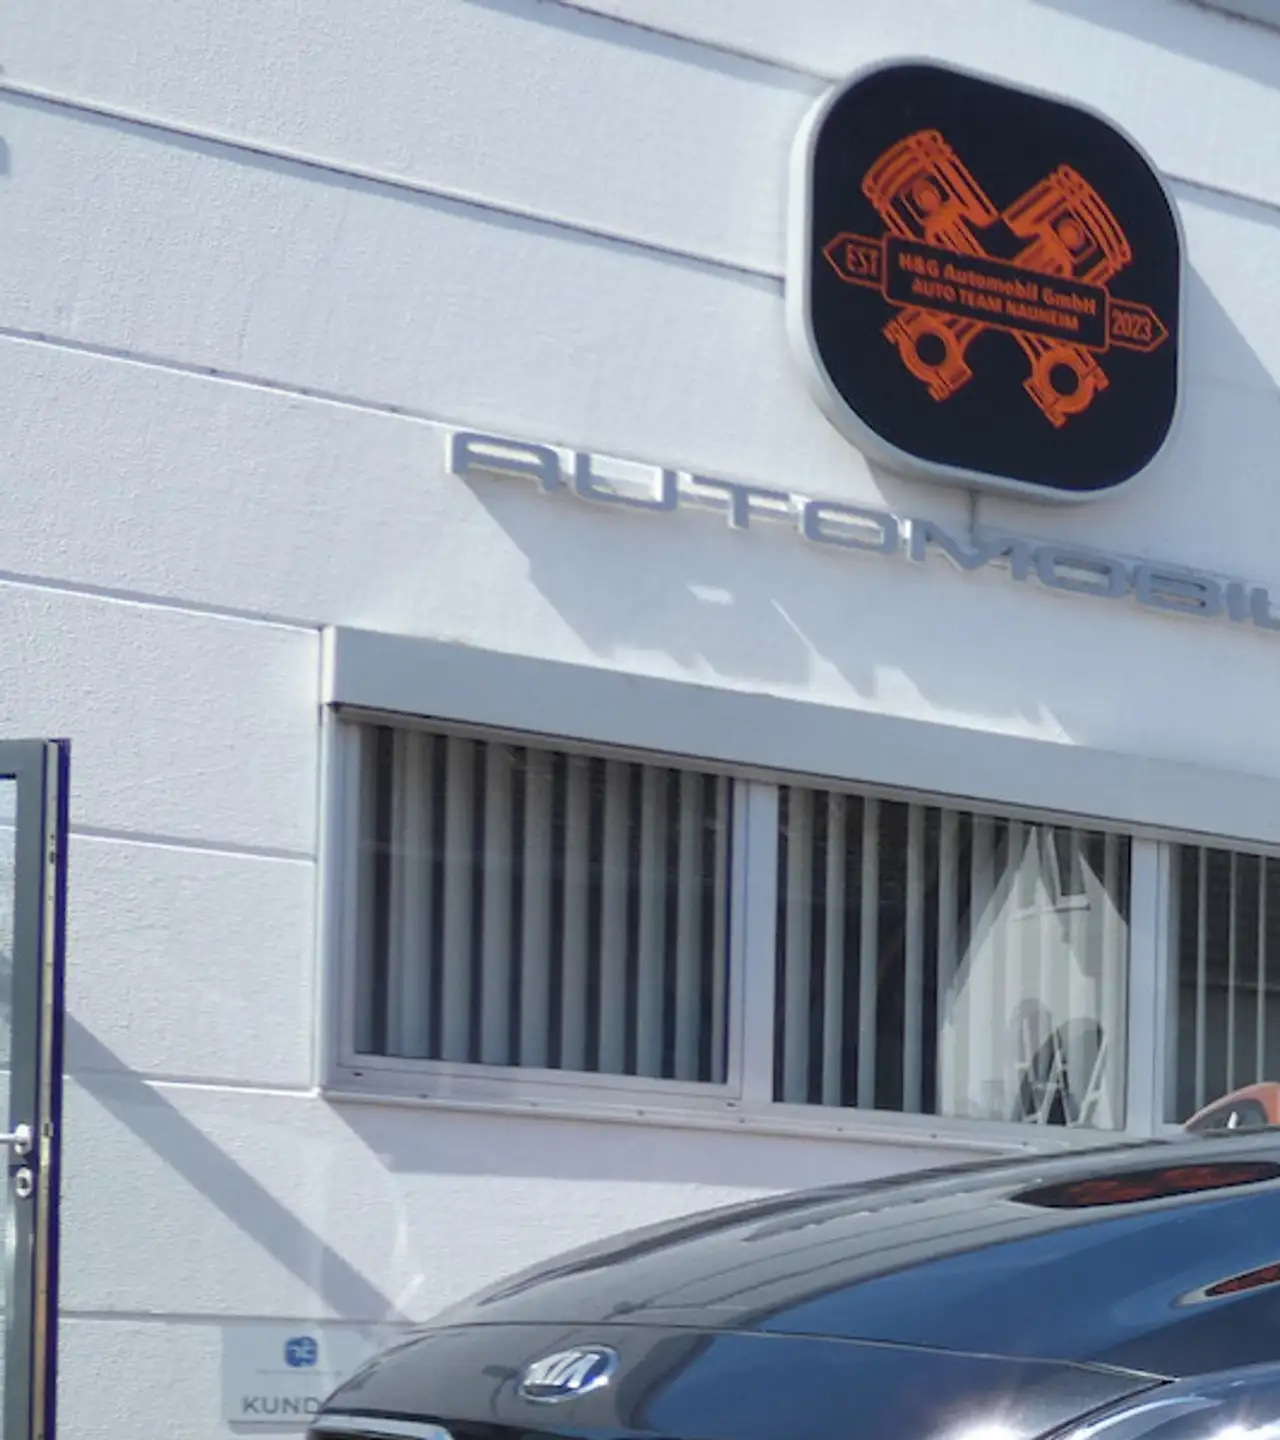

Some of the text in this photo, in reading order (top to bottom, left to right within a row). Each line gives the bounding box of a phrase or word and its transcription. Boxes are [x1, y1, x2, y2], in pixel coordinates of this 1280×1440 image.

[899, 251, 1096, 317] H&G Automobil GmbH
[912, 279, 956, 302] AUTO
[959, 290, 1001, 314] TEAM
[1111, 311, 1151, 340] 2023
